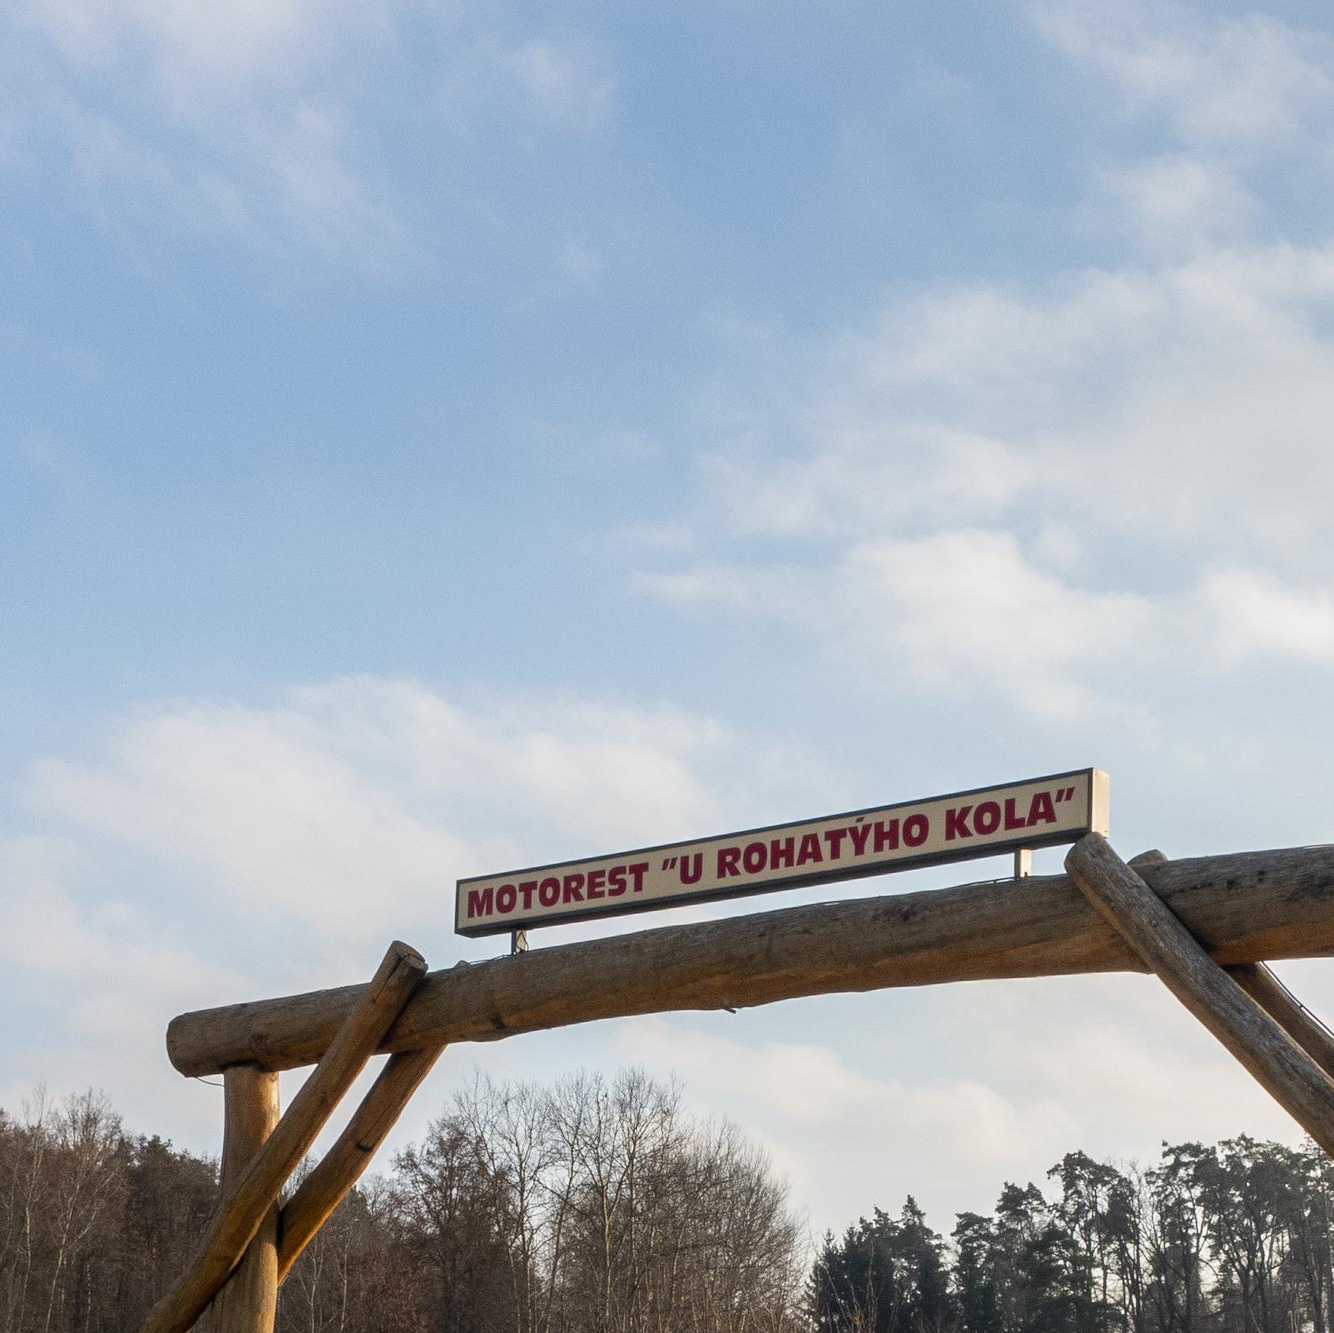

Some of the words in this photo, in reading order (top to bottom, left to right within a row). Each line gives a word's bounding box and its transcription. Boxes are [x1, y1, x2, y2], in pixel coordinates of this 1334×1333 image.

[467, 862, 649, 919] MOTOREST
[716, 815, 929, 879] ROHATÝHO
[944, 786, 1076, 841] KOLA"
